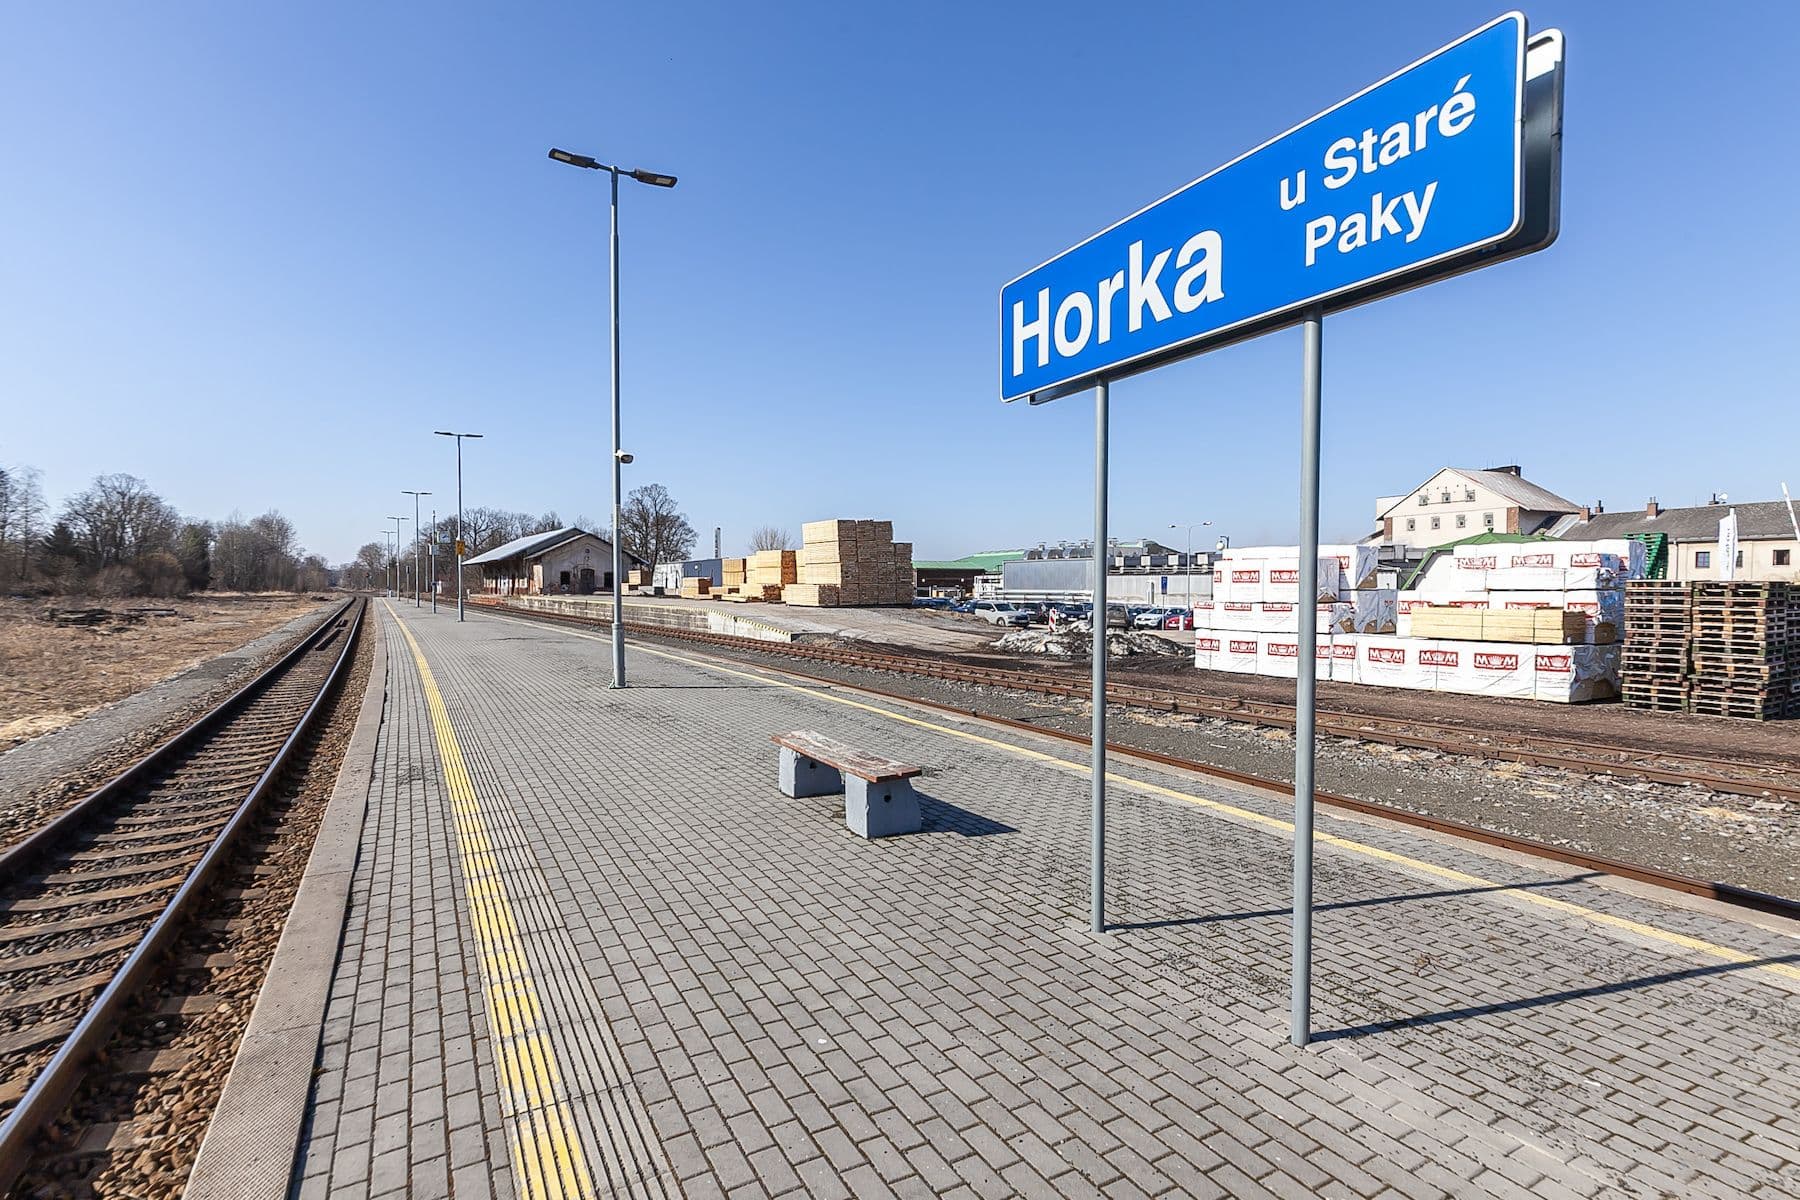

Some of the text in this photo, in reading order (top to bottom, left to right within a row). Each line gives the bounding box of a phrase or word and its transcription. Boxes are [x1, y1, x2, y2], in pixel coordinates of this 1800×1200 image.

[1280, 75, 1476, 211] u Staré
[1305, 181, 1438, 267] Paky
[1012, 230, 1225, 377] Horka
